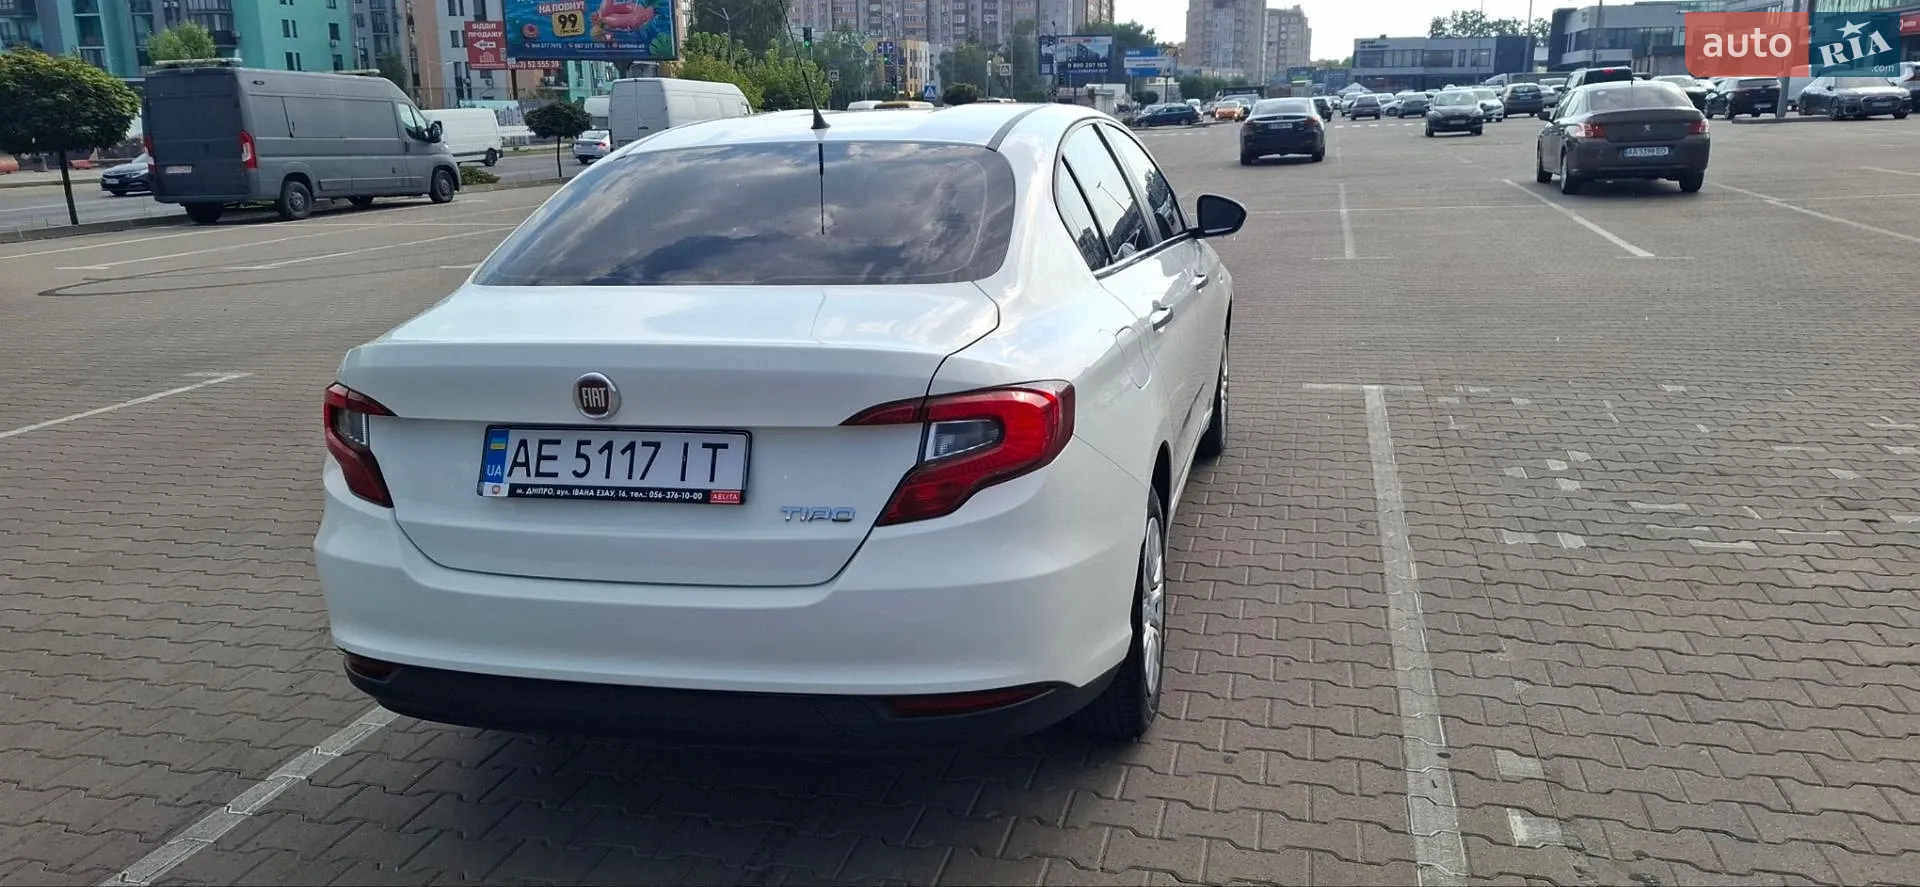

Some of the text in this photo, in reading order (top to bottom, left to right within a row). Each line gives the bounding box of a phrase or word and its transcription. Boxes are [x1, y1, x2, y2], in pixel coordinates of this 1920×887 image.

[539, 1, 585, 14] НА ПОВНУ!
[558, 13, 578, 29] 99
[581, 387, 606, 408] FIAT
[507, 438, 729, 483] AE 5117 IT
[486, 464, 502, 477] UA
[572, 488, 594, 497] ІВАНА
[649, 490, 703, 500] 056-376-10-00
